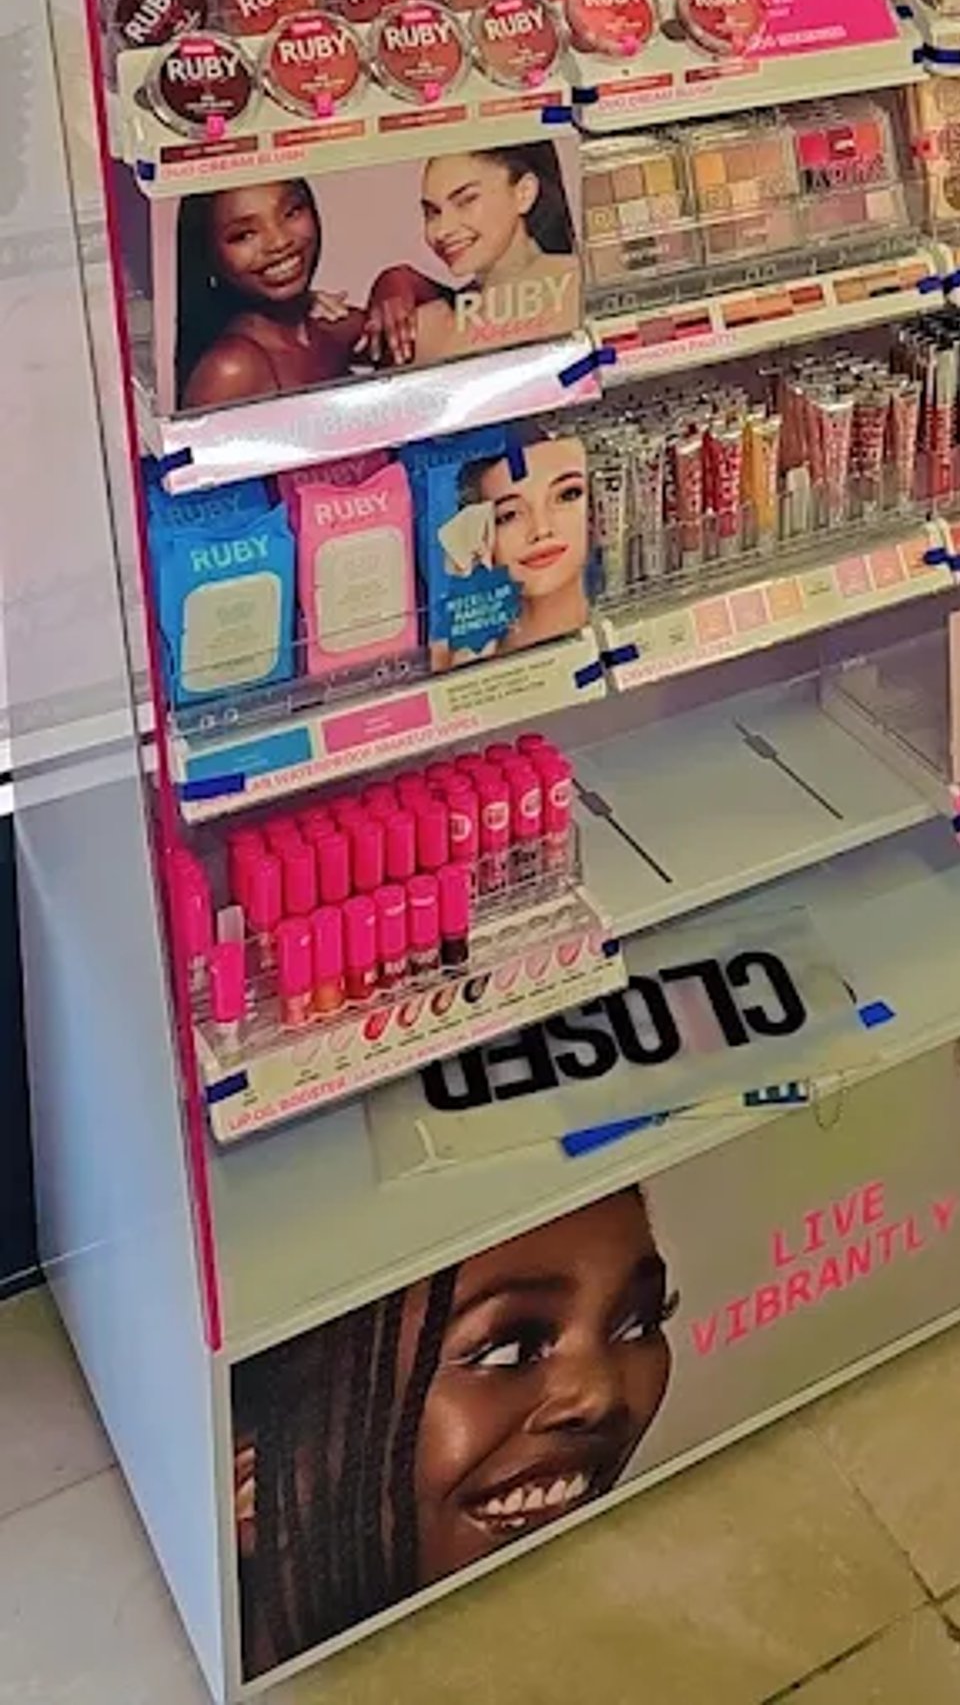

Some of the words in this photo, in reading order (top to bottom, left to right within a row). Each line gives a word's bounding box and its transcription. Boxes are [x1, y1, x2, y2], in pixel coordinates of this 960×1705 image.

[384, 19, 452, 50] RUBY
[484, 5, 546, 41] RUBY
[278, 34, 349, 64] RUBY
[166, 54, 237, 83] RUBY
[161, 164, 194, 180] DUO
[200, 155, 254, 175] CREAM
[455, 273, 574, 332] RUBY
[315, 490, 391, 527] RUBY
[190, 533, 270, 573] RUBY
[418, 951, 807, 1111] CLOSED
[772, 1181, 885, 1267] LIVE
[692, 1197, 956, 1355] VIBRANTLY
